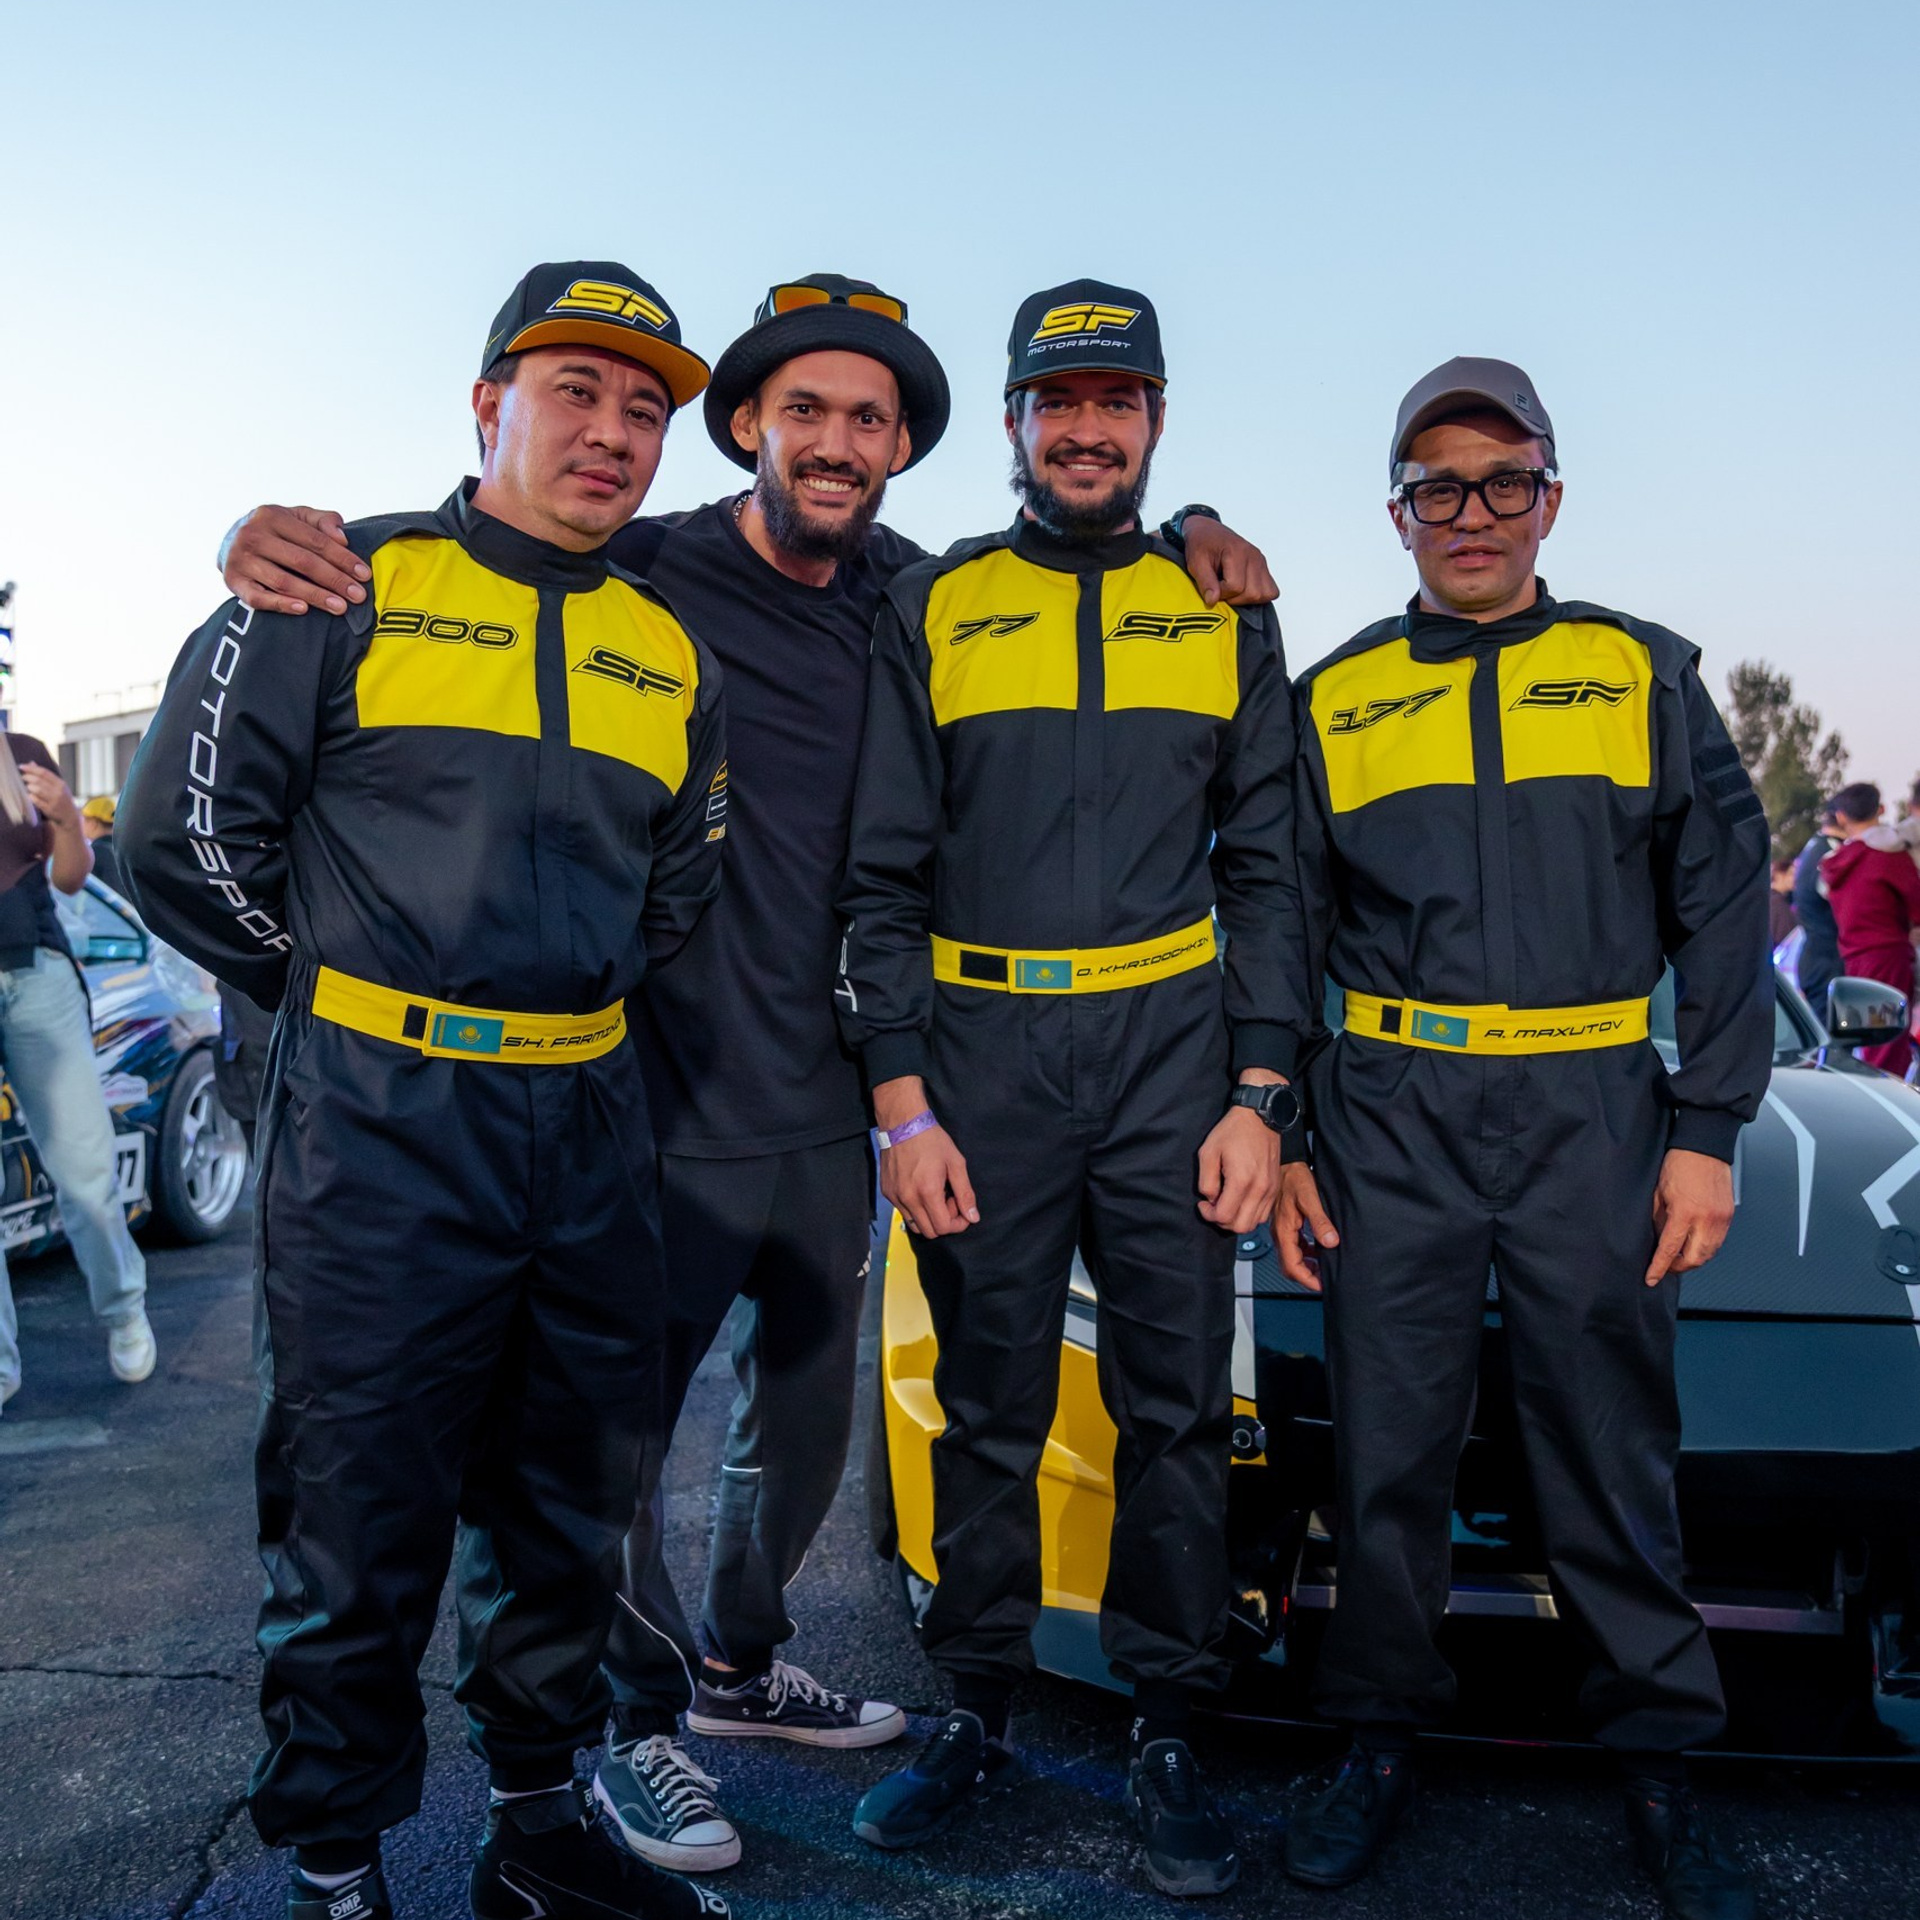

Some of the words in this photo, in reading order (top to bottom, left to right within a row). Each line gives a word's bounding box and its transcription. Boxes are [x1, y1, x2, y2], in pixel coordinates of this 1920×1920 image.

[546, 279, 671, 331] SF
[1028, 302, 1141, 347] SF
[1027, 338, 1131, 357] MOTORSPORT
[374, 607, 519, 650] 900
[950, 611, 1040, 646] 77
[1103, 611, 1228, 643] SF
[571, 645, 686, 699] SF
[1328, 685, 1452, 735] 177
[1508, 677, 1639, 712] SF
[501, 1036, 545, 1049] SH.
[1513, 1019, 1624, 1038] MAXUTOV
[329, 1894, 362, 1918] OMP
